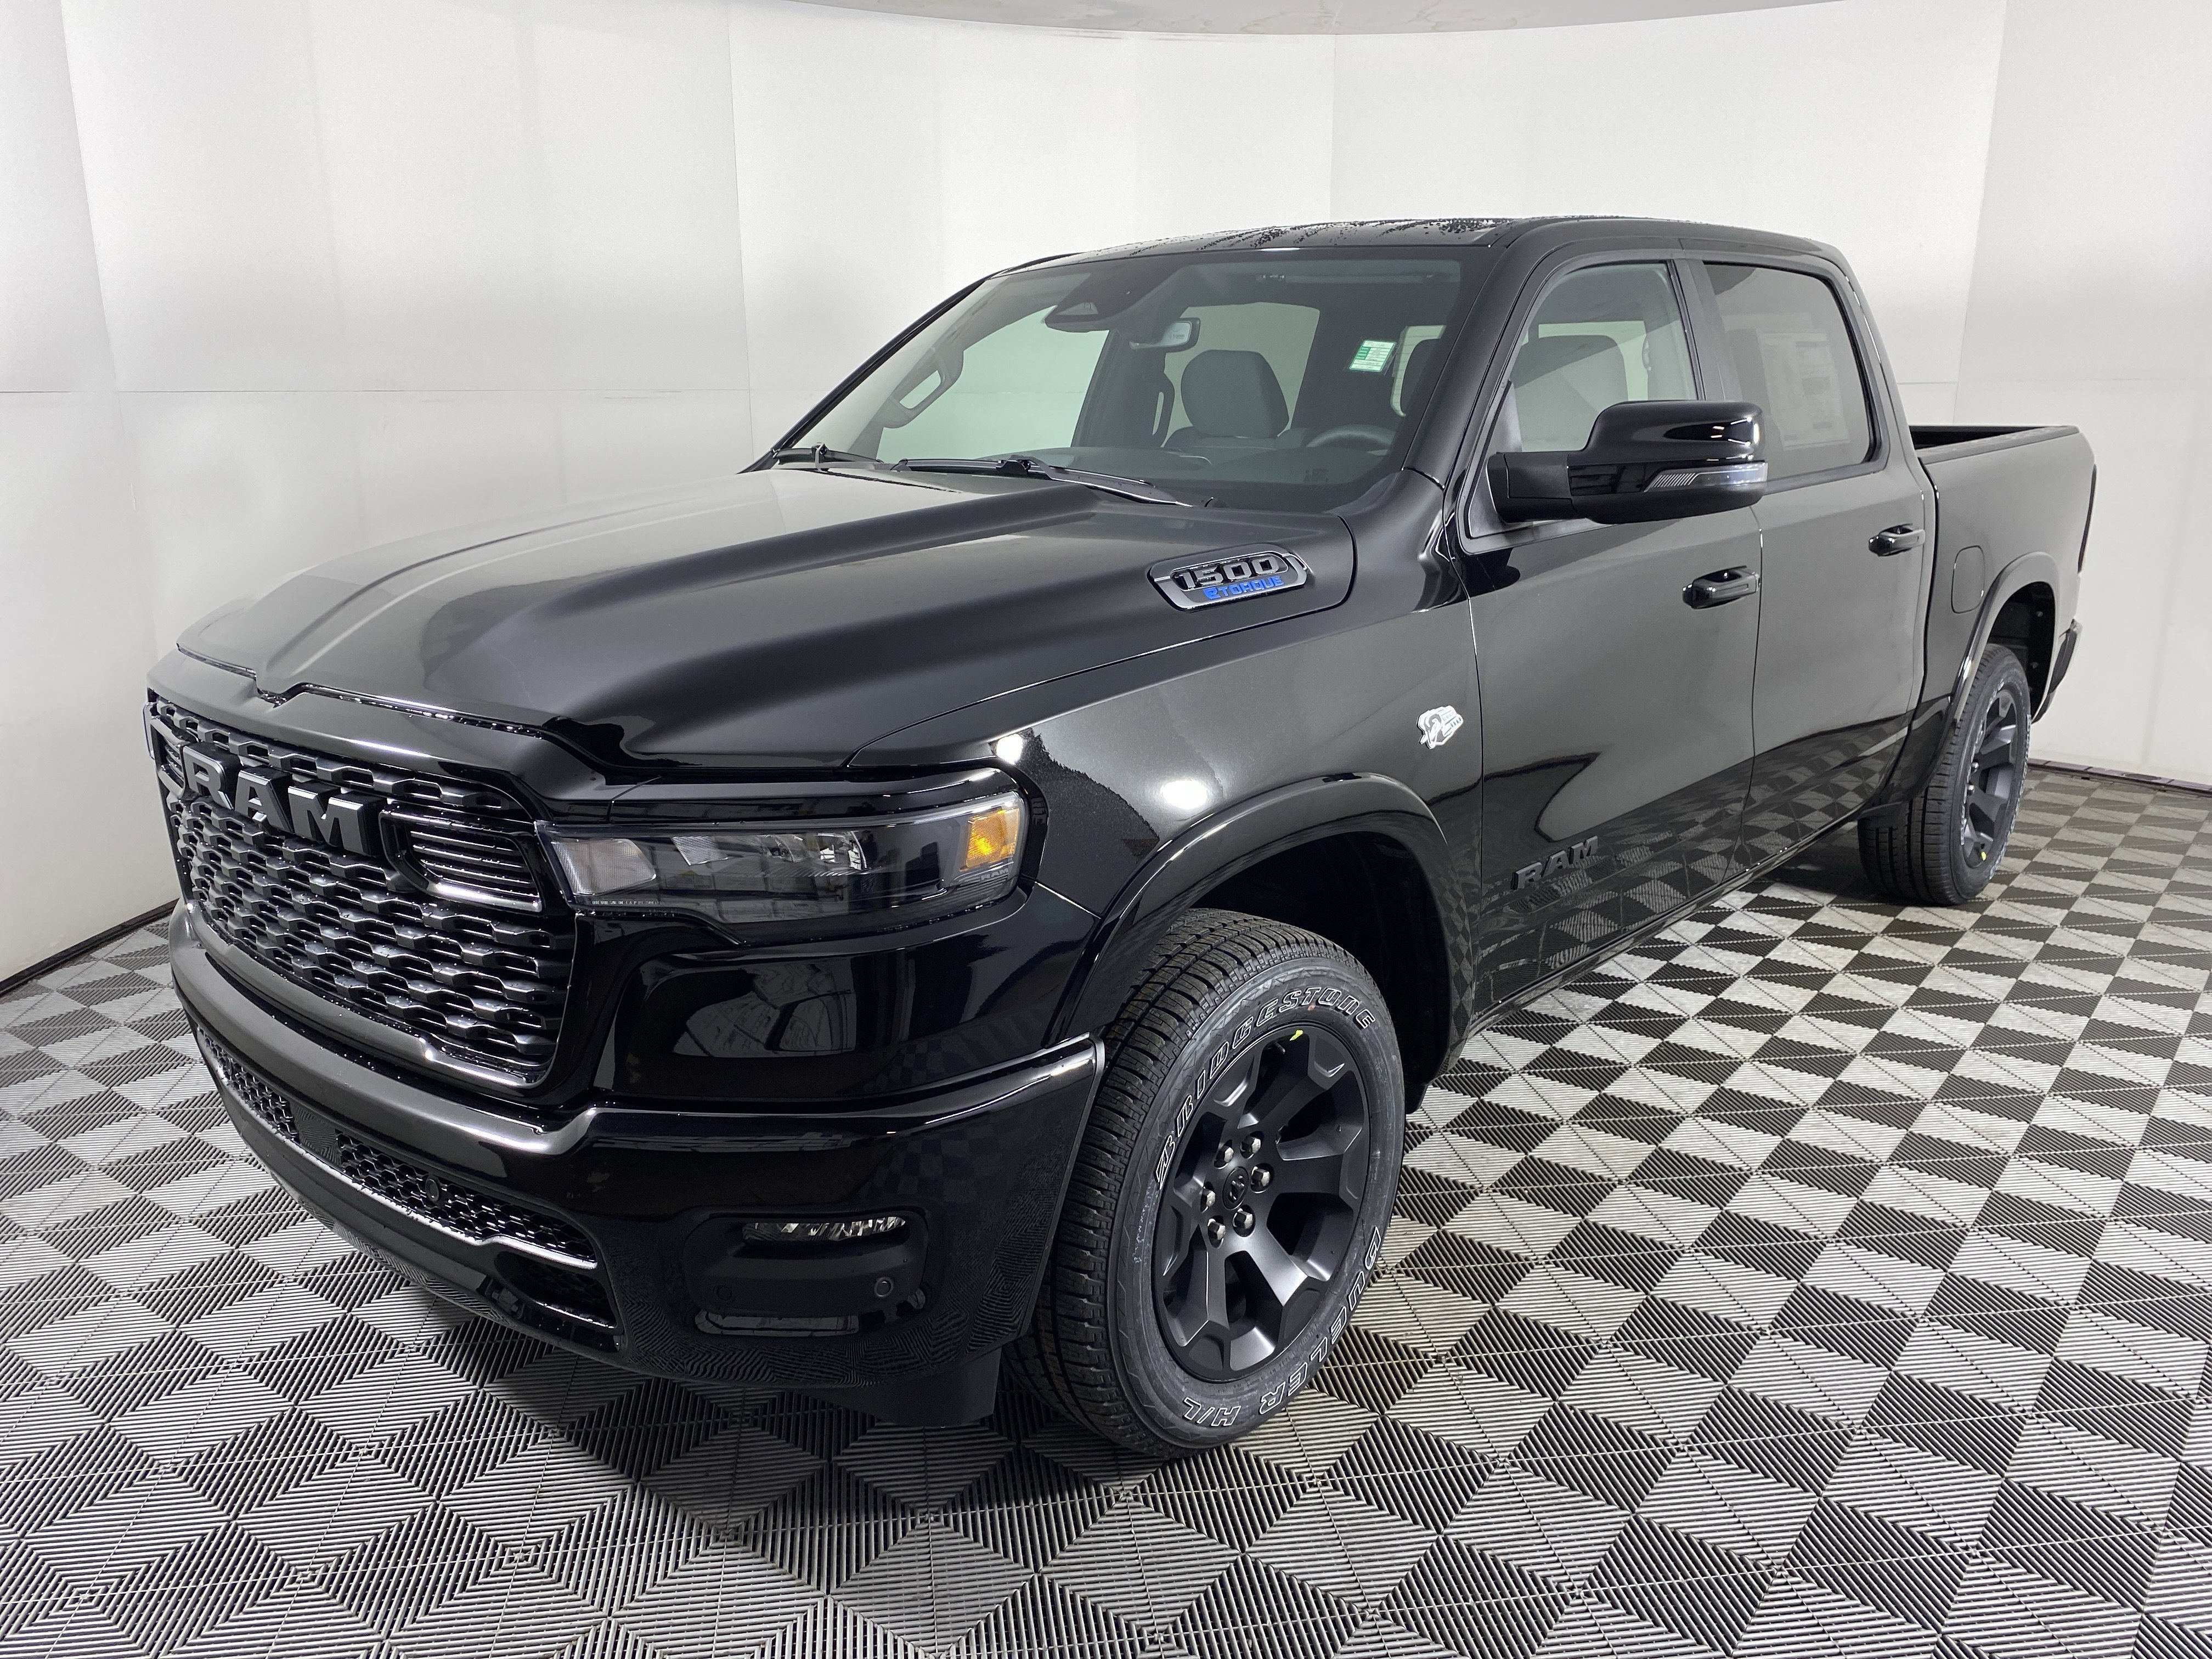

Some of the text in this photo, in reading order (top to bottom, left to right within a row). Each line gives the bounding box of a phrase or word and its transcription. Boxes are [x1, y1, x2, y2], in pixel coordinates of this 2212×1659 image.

[1173, 555, 1279, 590] 1500
[183, 742, 385, 856] RAM
[981, 868, 1009, 881] RAM
[1510, 835, 1598, 890] RAM
[1155, 987, 1376, 1190] BRIDGESTONE
[1183, 1226, 1382, 1426] DUELER H/L
